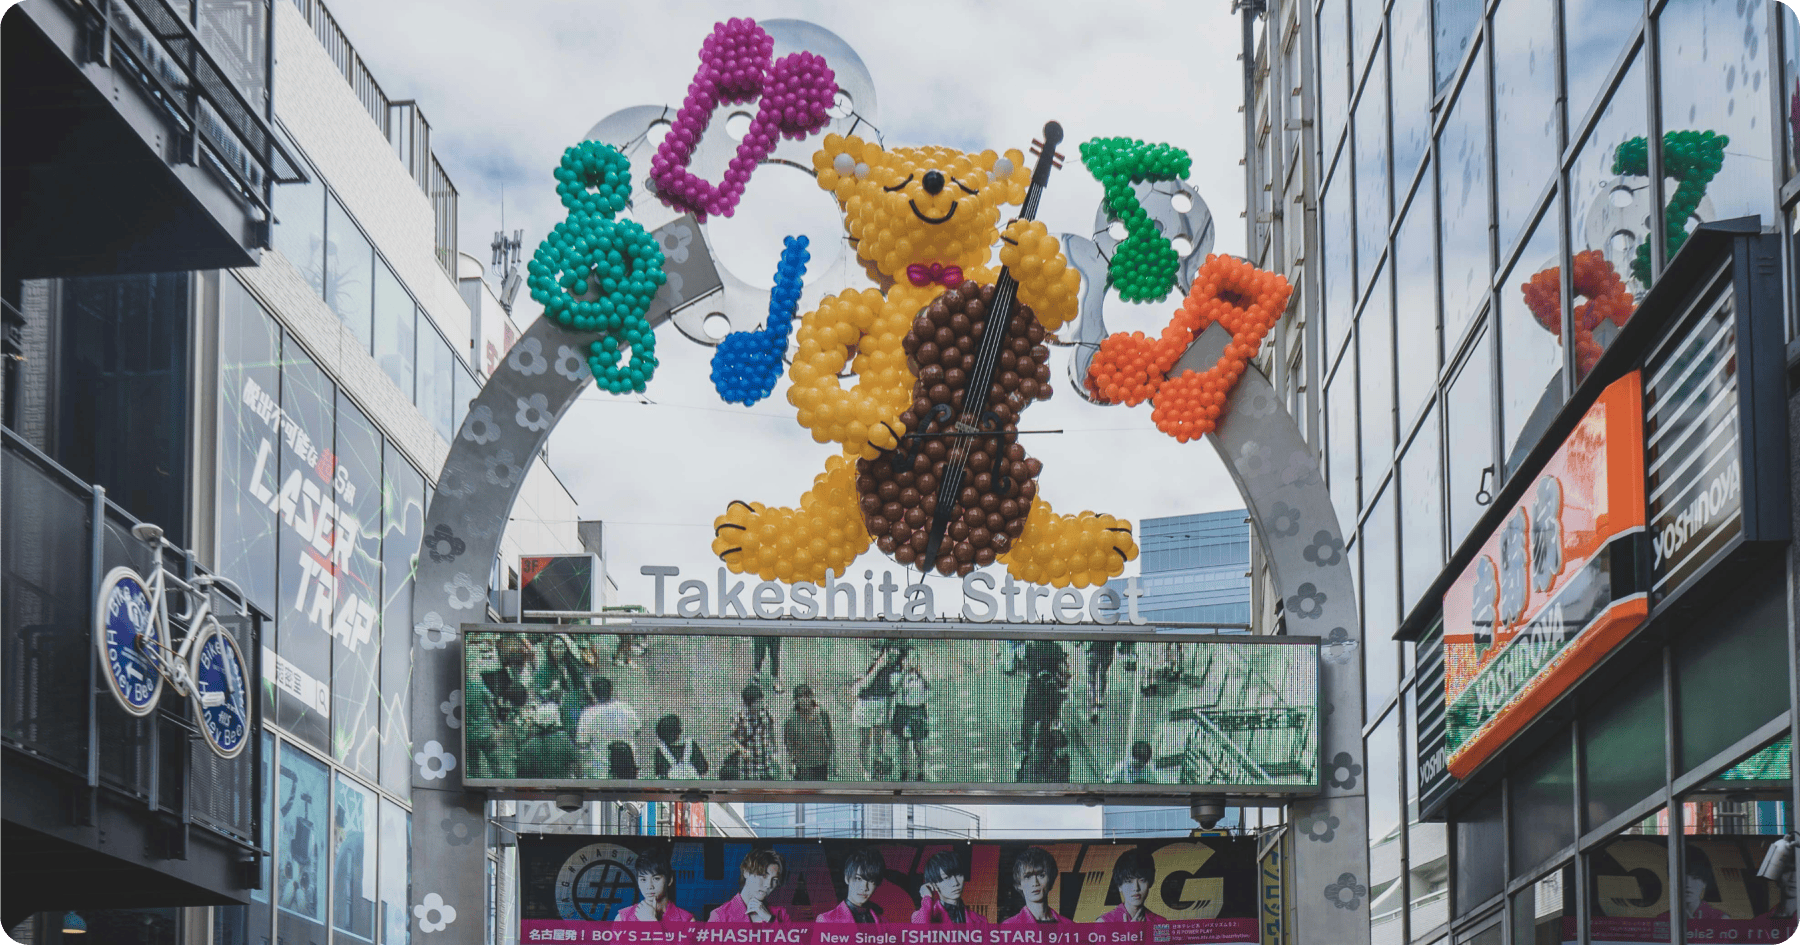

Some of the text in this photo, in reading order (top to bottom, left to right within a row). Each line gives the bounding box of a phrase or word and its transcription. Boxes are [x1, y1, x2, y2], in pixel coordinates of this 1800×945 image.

[249, 437, 360, 576] LASER
[1652, 458, 1740, 571] YOSHINOYA
[523, 559, 539, 573] 3F
[640, 565, 1148, 626] Takeshita Street
[295, 550, 377, 654] TRAP
[106, 629, 132, 699] Honey
[201, 641, 221, 670] Bike
[1475, 602, 1565, 723] YOSHINOYA
[199, 681, 221, 743] Hney
[224, 724, 242, 746] Bee
[592, 930, 637, 942] BOY'S
[820, 932, 850, 943] New
[855, 932, 897, 945] Single
[1048, 932, 1079, 944] 9/11
[1088, 932, 1106, 943] On
[1111, 931, 1144, 943] Sale!
